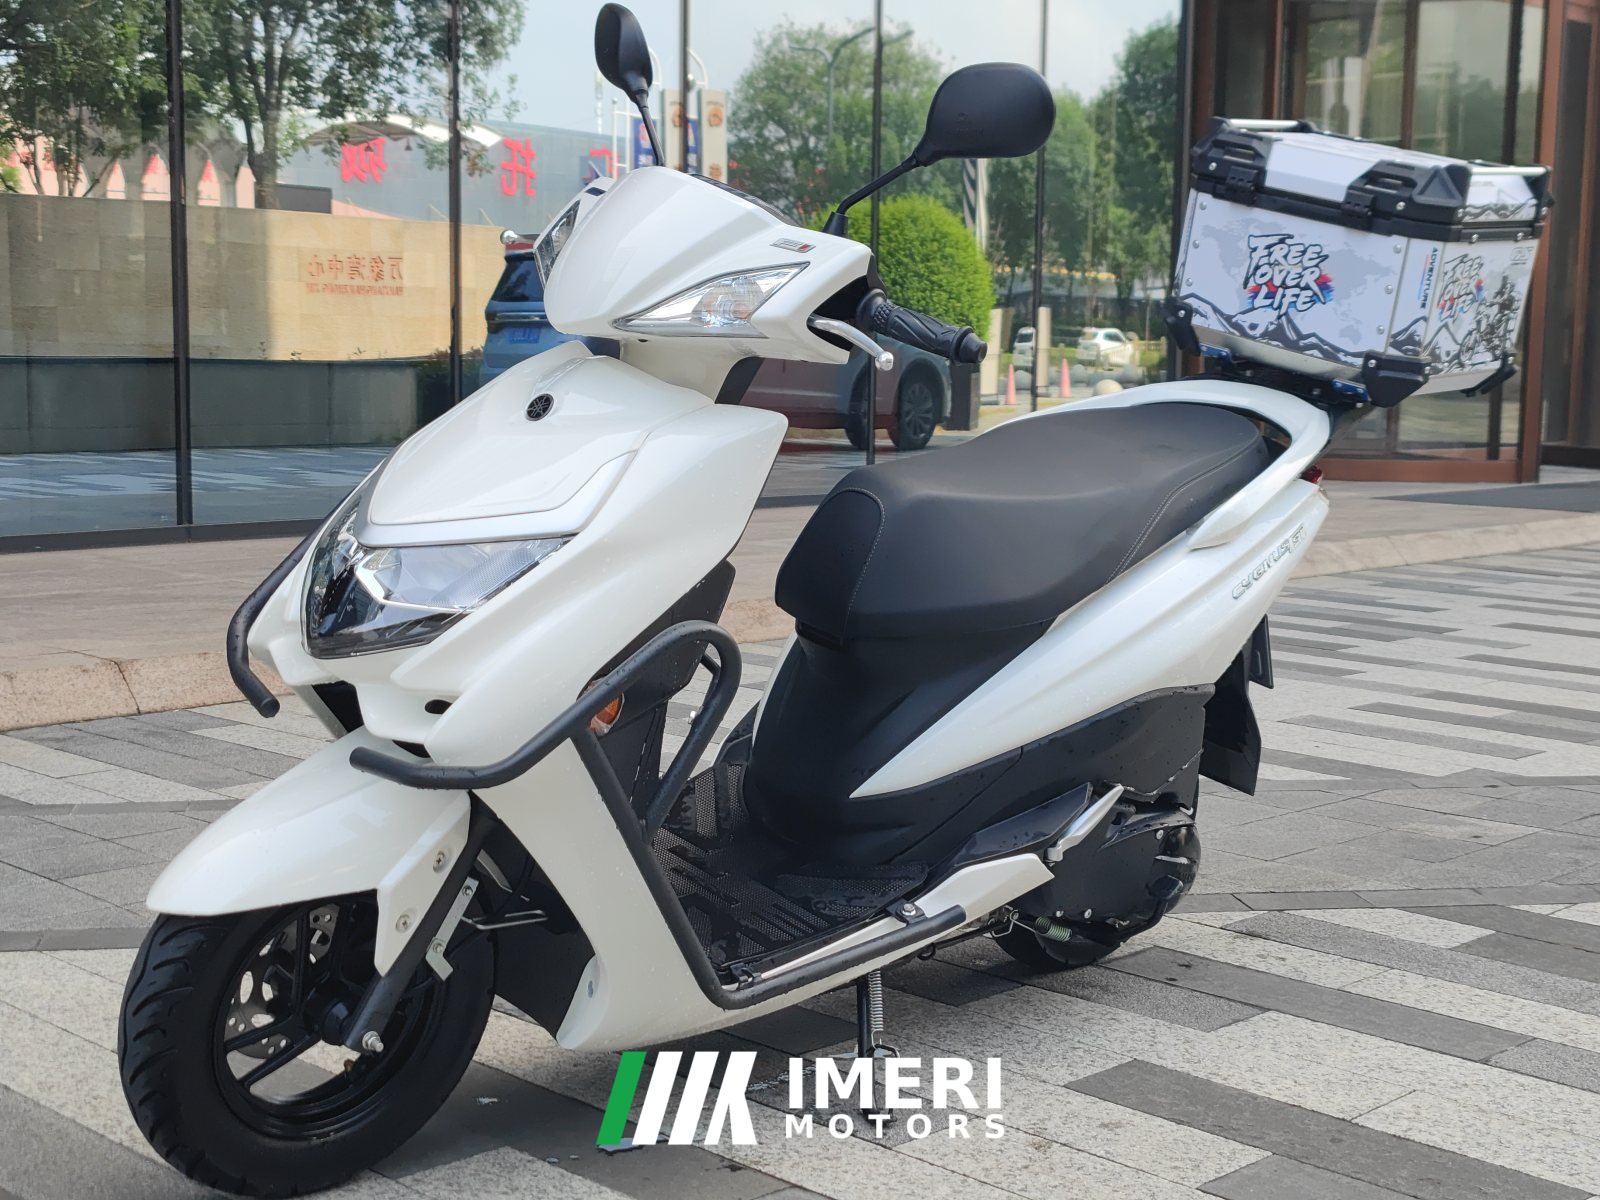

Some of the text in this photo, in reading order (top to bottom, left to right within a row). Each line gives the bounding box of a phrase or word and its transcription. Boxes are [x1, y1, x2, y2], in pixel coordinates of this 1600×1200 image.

[1243, 233, 1330, 290] FREE
[1253, 264, 1326, 305] OVER
[1419, 247, 1439, 309] ADVENTURE
[1252, 285, 1317, 318] LIFE
